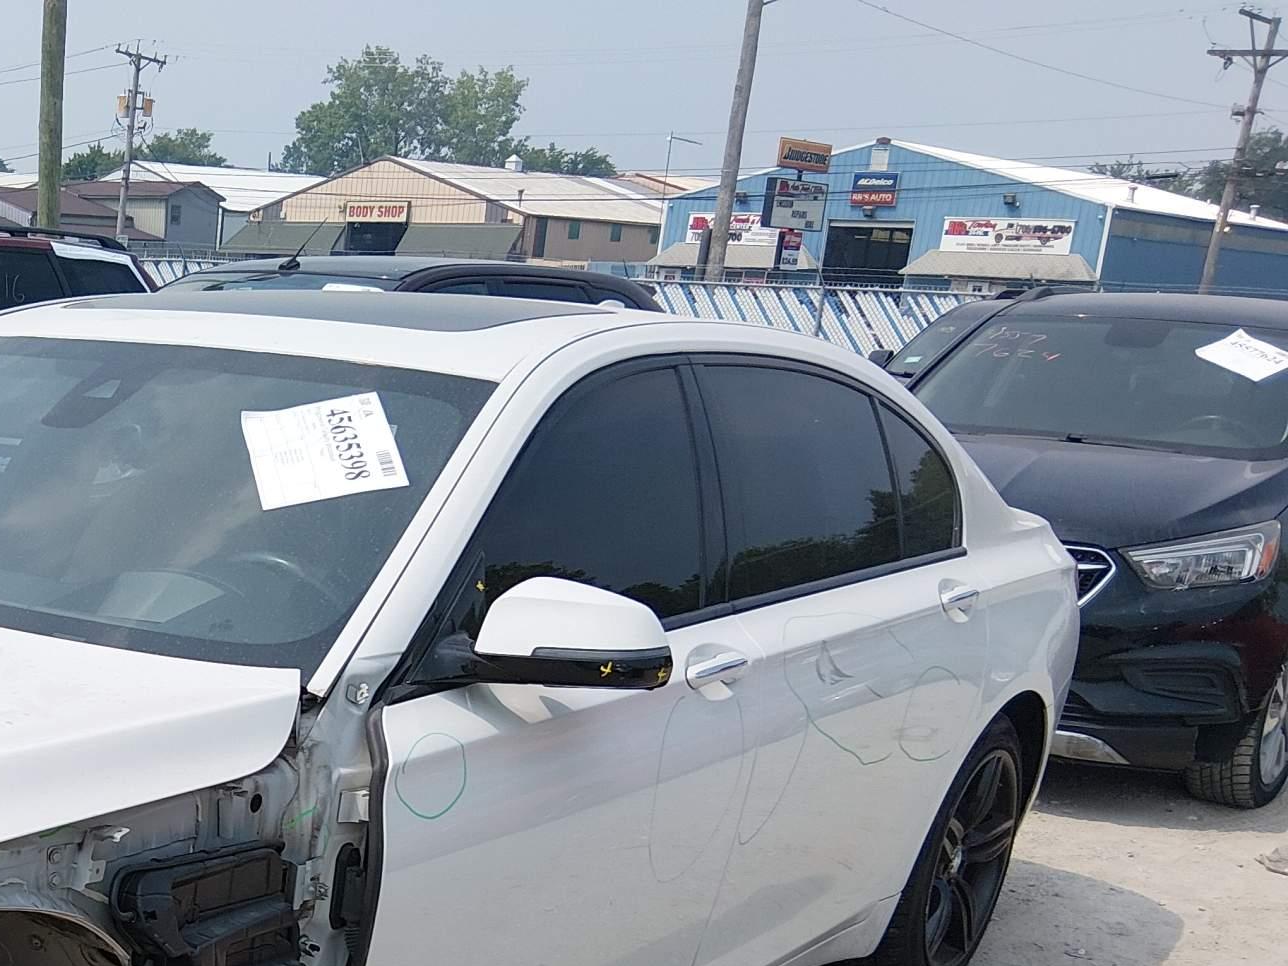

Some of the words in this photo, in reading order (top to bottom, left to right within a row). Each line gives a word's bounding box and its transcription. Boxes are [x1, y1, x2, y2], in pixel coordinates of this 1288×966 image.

[857, 178, 894, 186] ACDelco
[870, 193, 893, 201] AUTO
[349, 205, 375, 218] BODY
[376, 205, 405, 218] SHOP
[326, 408, 371, 481] 45635398
